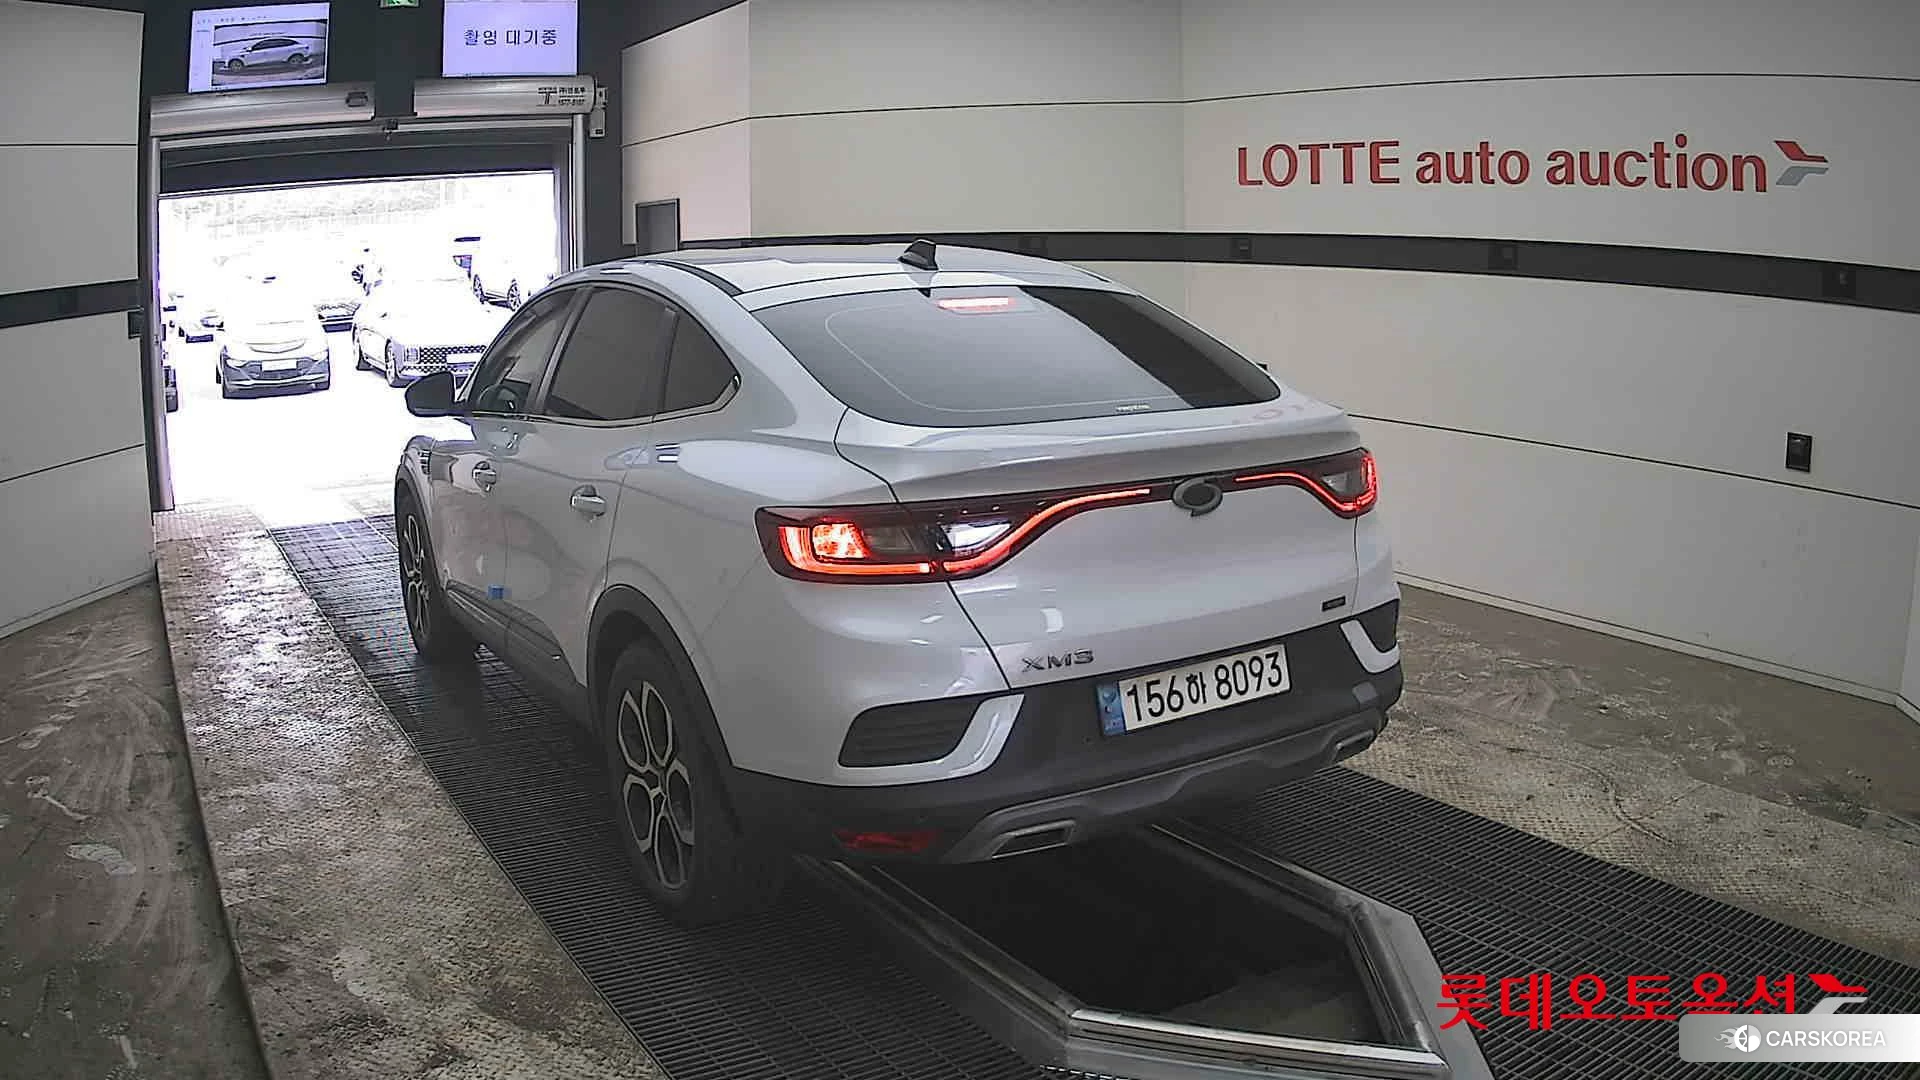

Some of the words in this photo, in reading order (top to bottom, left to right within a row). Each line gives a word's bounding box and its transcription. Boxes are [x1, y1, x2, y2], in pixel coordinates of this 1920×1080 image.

[505, 29, 557, 46] 대기중
[1238, 140, 1400, 187] LOTTE
[1415, 140, 1530, 186] auto
[1545, 133, 1767, 193] auction
[1021, 649, 1094, 673] XM3
[1126, 671, 1207, 722] 156하
[1214, 651, 1283, 700] 8093
